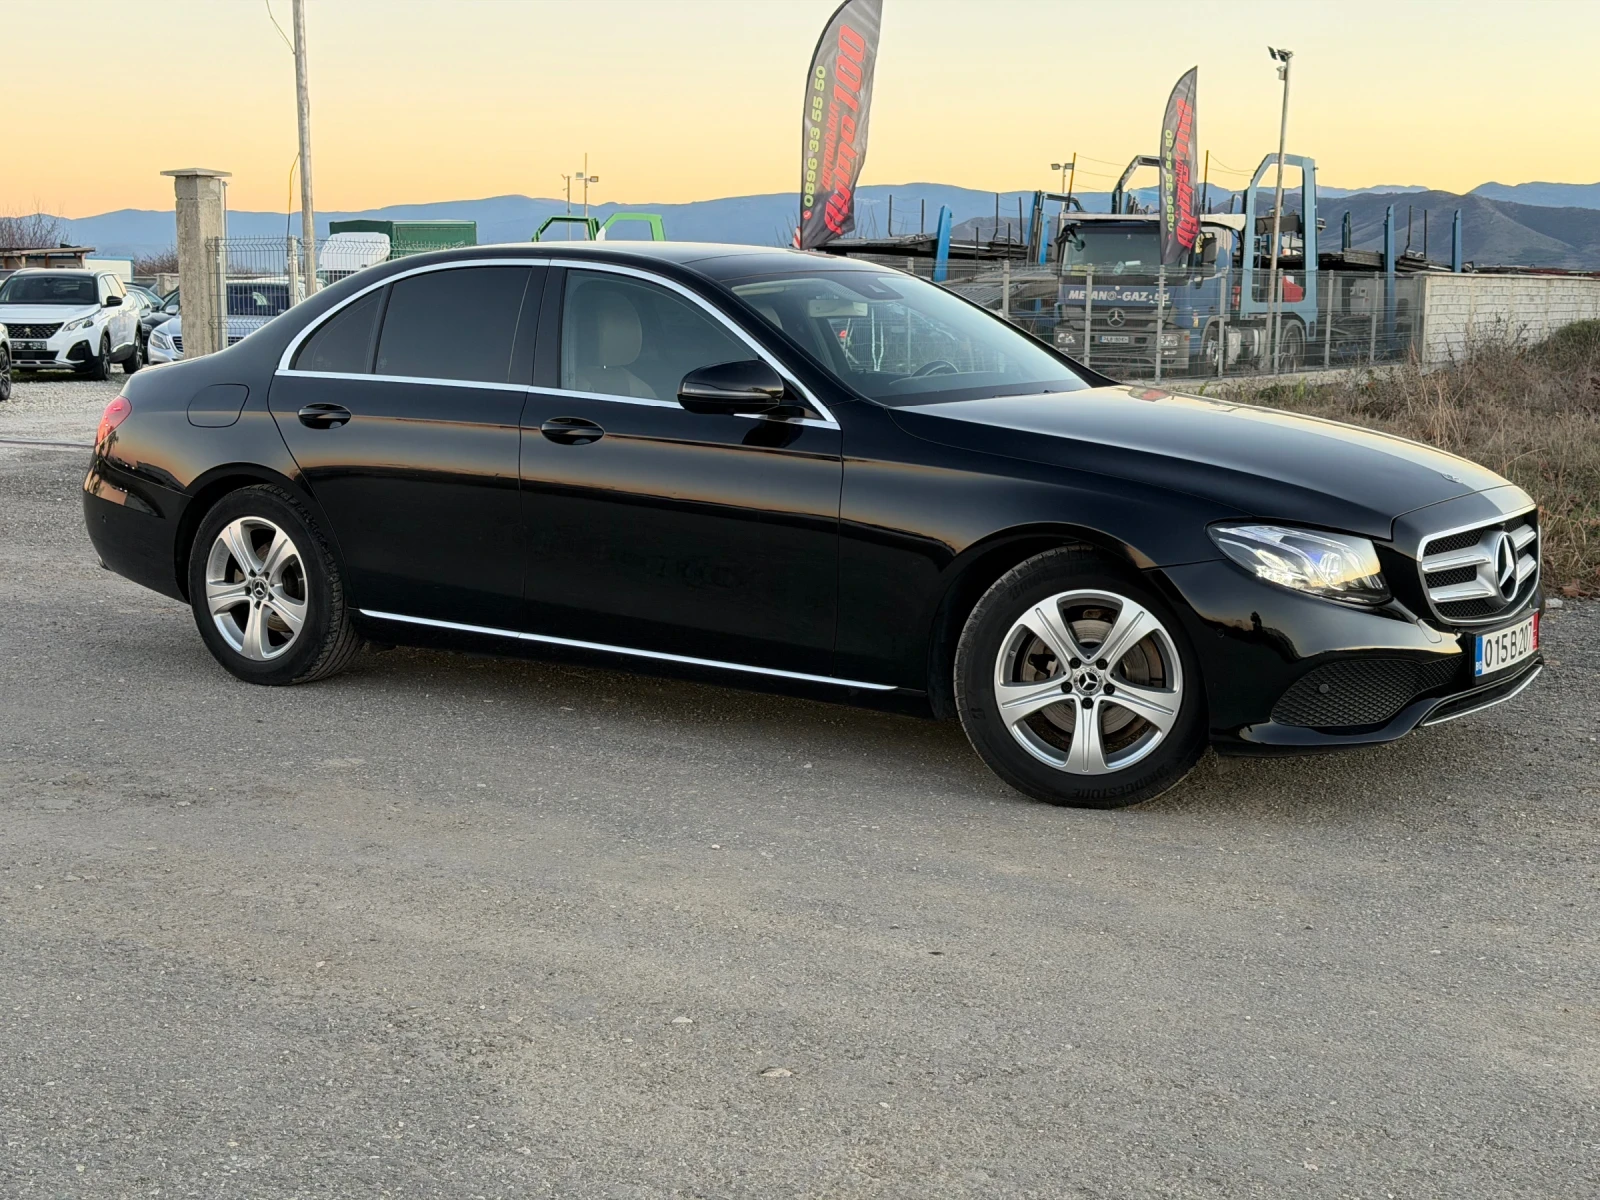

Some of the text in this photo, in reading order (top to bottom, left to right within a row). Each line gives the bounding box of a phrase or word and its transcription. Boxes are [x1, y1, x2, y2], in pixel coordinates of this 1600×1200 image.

[834, 24, 865, 113] 100
[804, 65, 827, 207] 0896 33 55 50
[1165, 174, 1174, 192] 33
